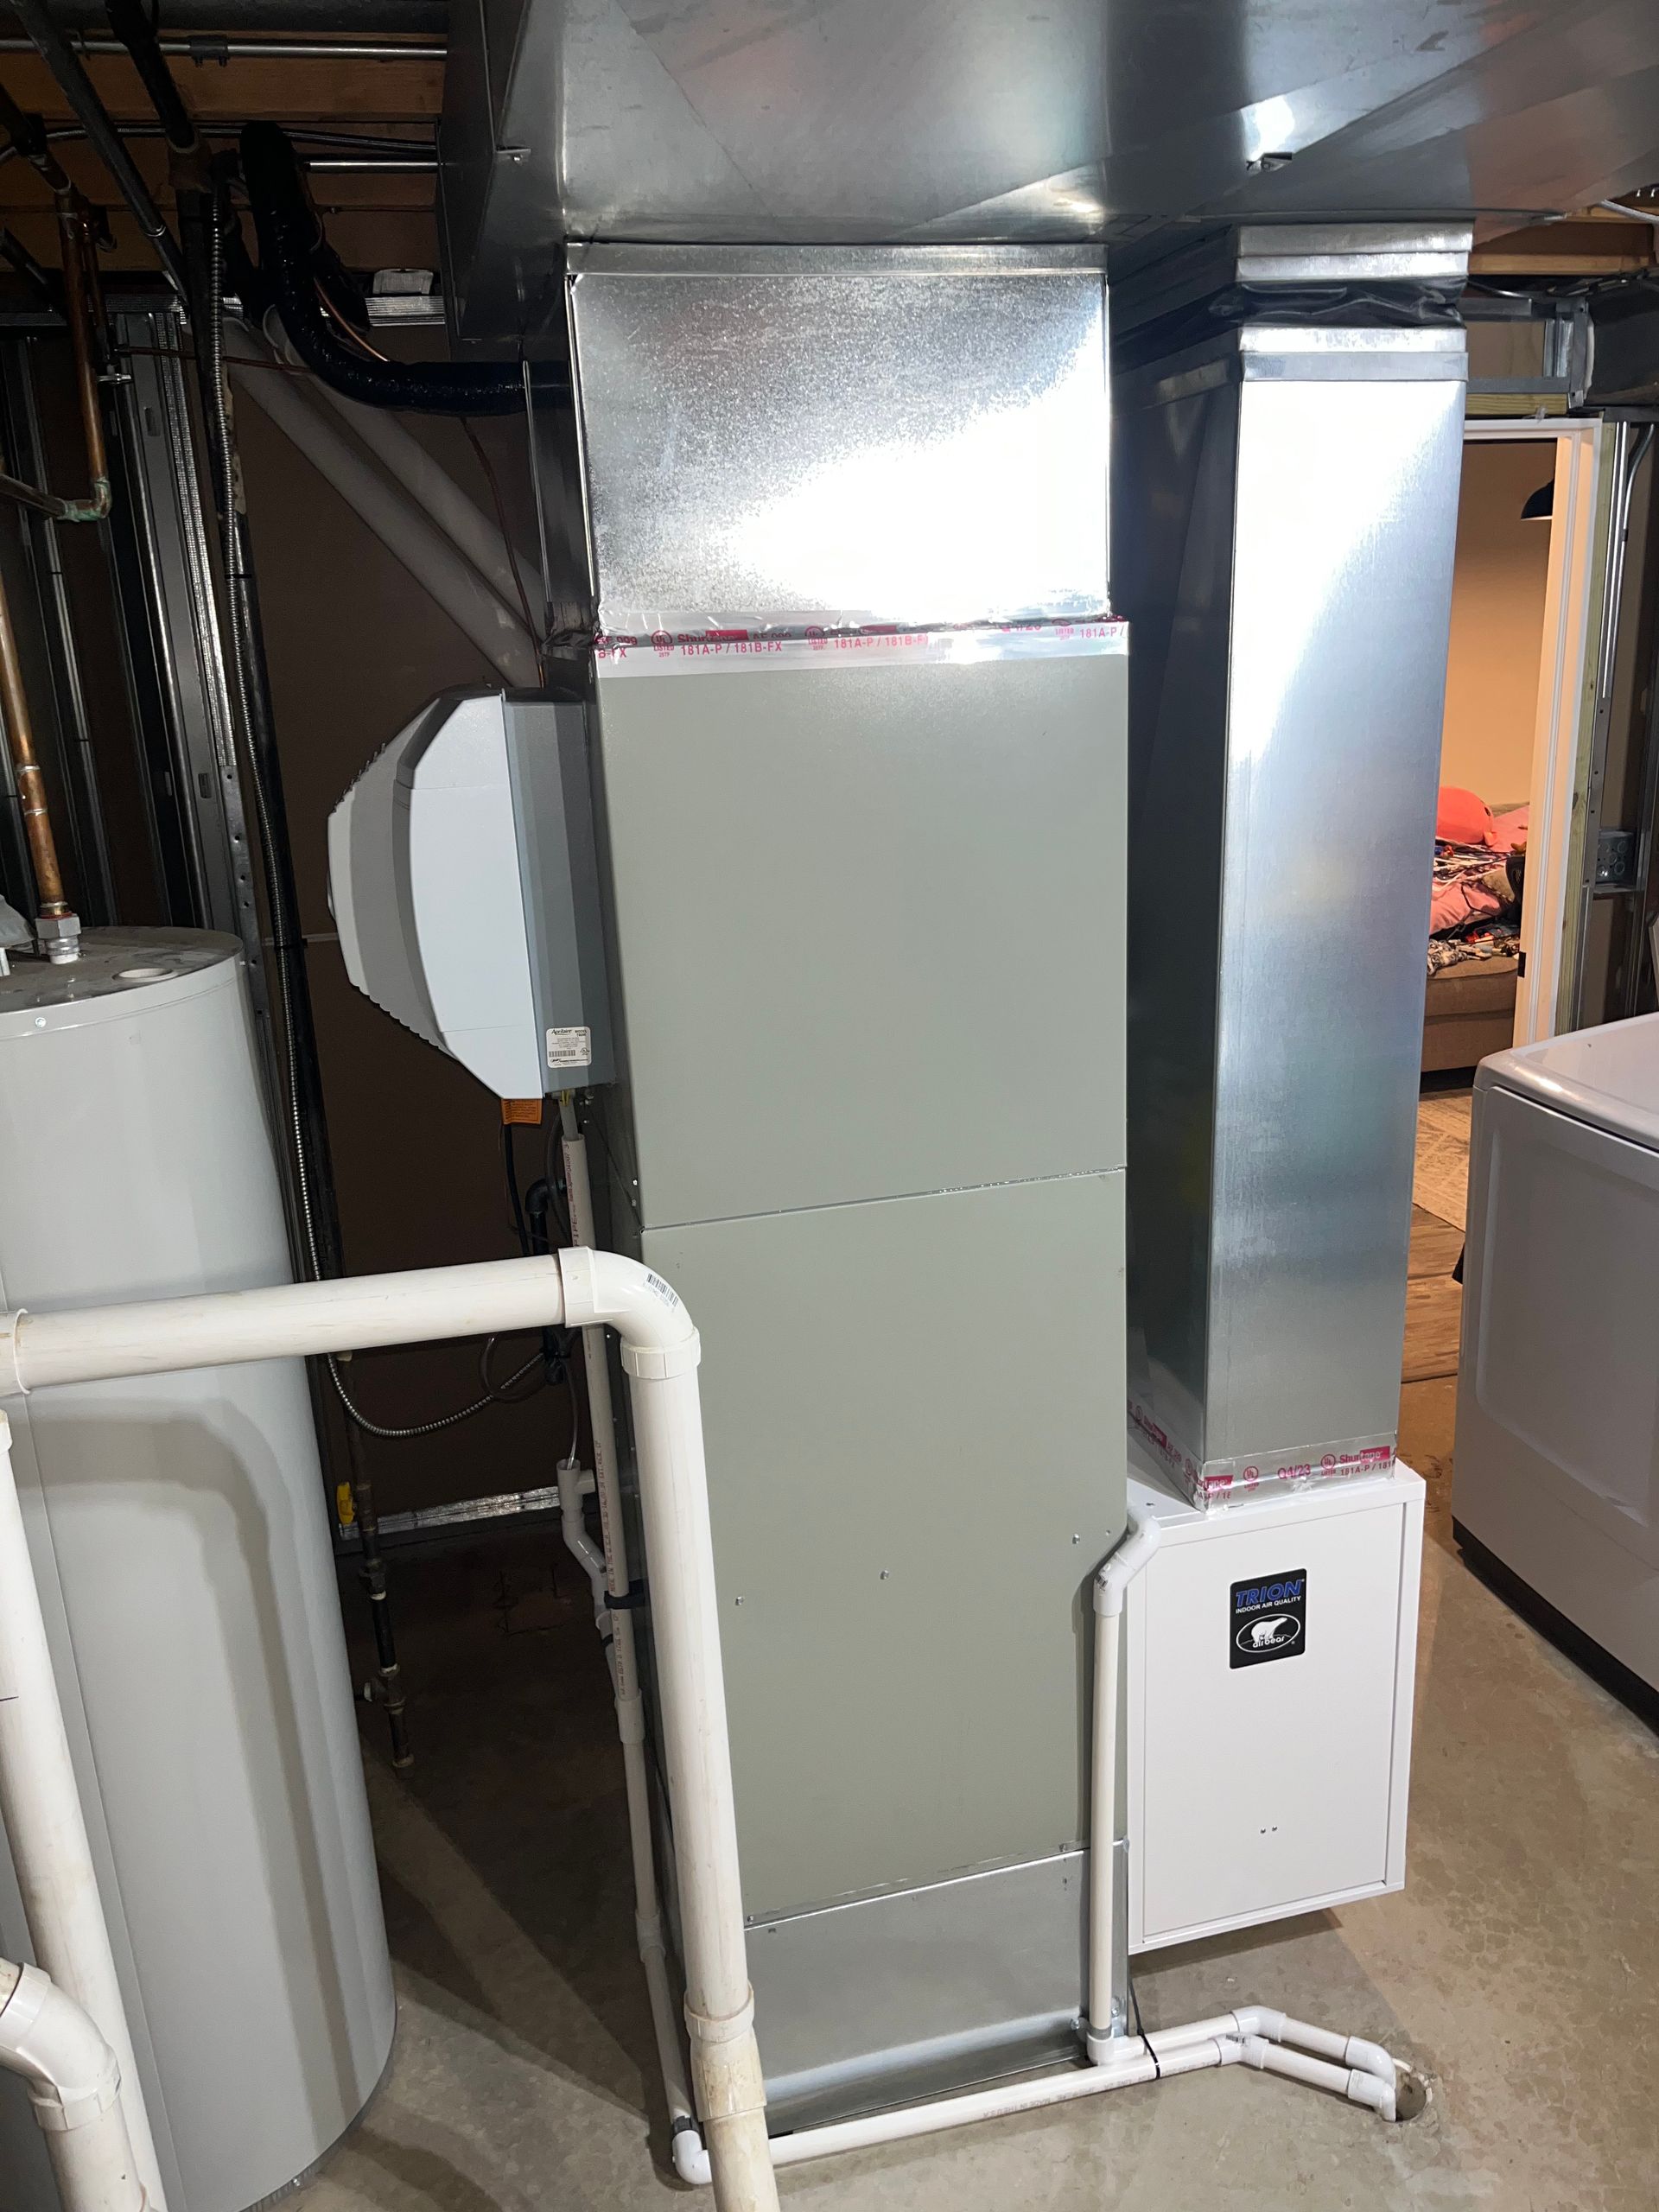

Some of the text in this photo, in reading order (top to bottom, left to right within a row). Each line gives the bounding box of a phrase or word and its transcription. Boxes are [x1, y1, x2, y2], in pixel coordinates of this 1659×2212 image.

[1079, 626, 1117, 639] 181A-P
[681, 640, 783, 655] 181A-P / 181B-FX
[833, 637, 874, 649] 181A-P
[1278, 1464, 1311, 1479] Q4/23
[1340, 1465, 1370, 1476] 181A-P
[1236, 1580, 1302, 1607] TRION
[1236, 1604, 1261, 1614] INDOOR
[1274, 1595, 1302, 1606] QUALITY
